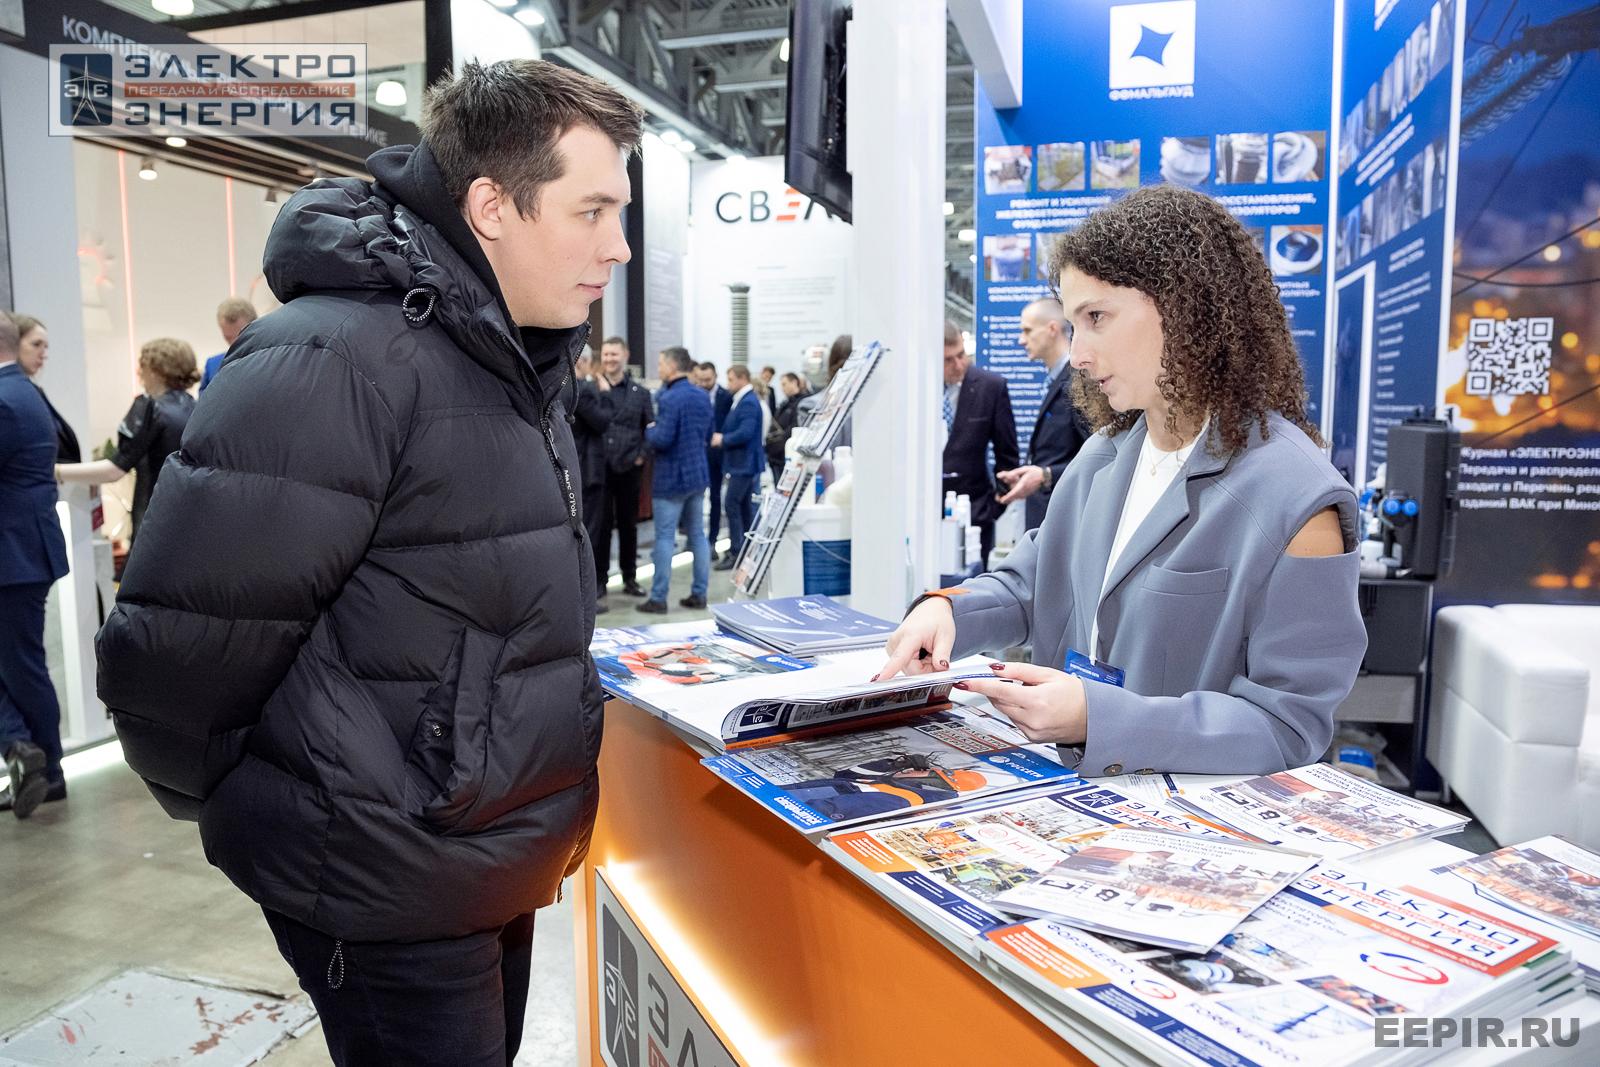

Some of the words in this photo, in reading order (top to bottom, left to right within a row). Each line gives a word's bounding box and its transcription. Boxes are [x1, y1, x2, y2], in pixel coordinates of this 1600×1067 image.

[1459, 463, 1518, 477] Передача
[1519, 467, 1528, 475] и
[1502, 483, 1512, 492] в
[1513, 481, 1574, 494] Перечень
[1508, 498, 1536, 509] ВАК
[1537, 500, 1562, 512] при
[1321, 869, 1520, 946] ЭЛЕКТРО
[1296, 879, 1496, 958] ЭНЕРГИЯ
